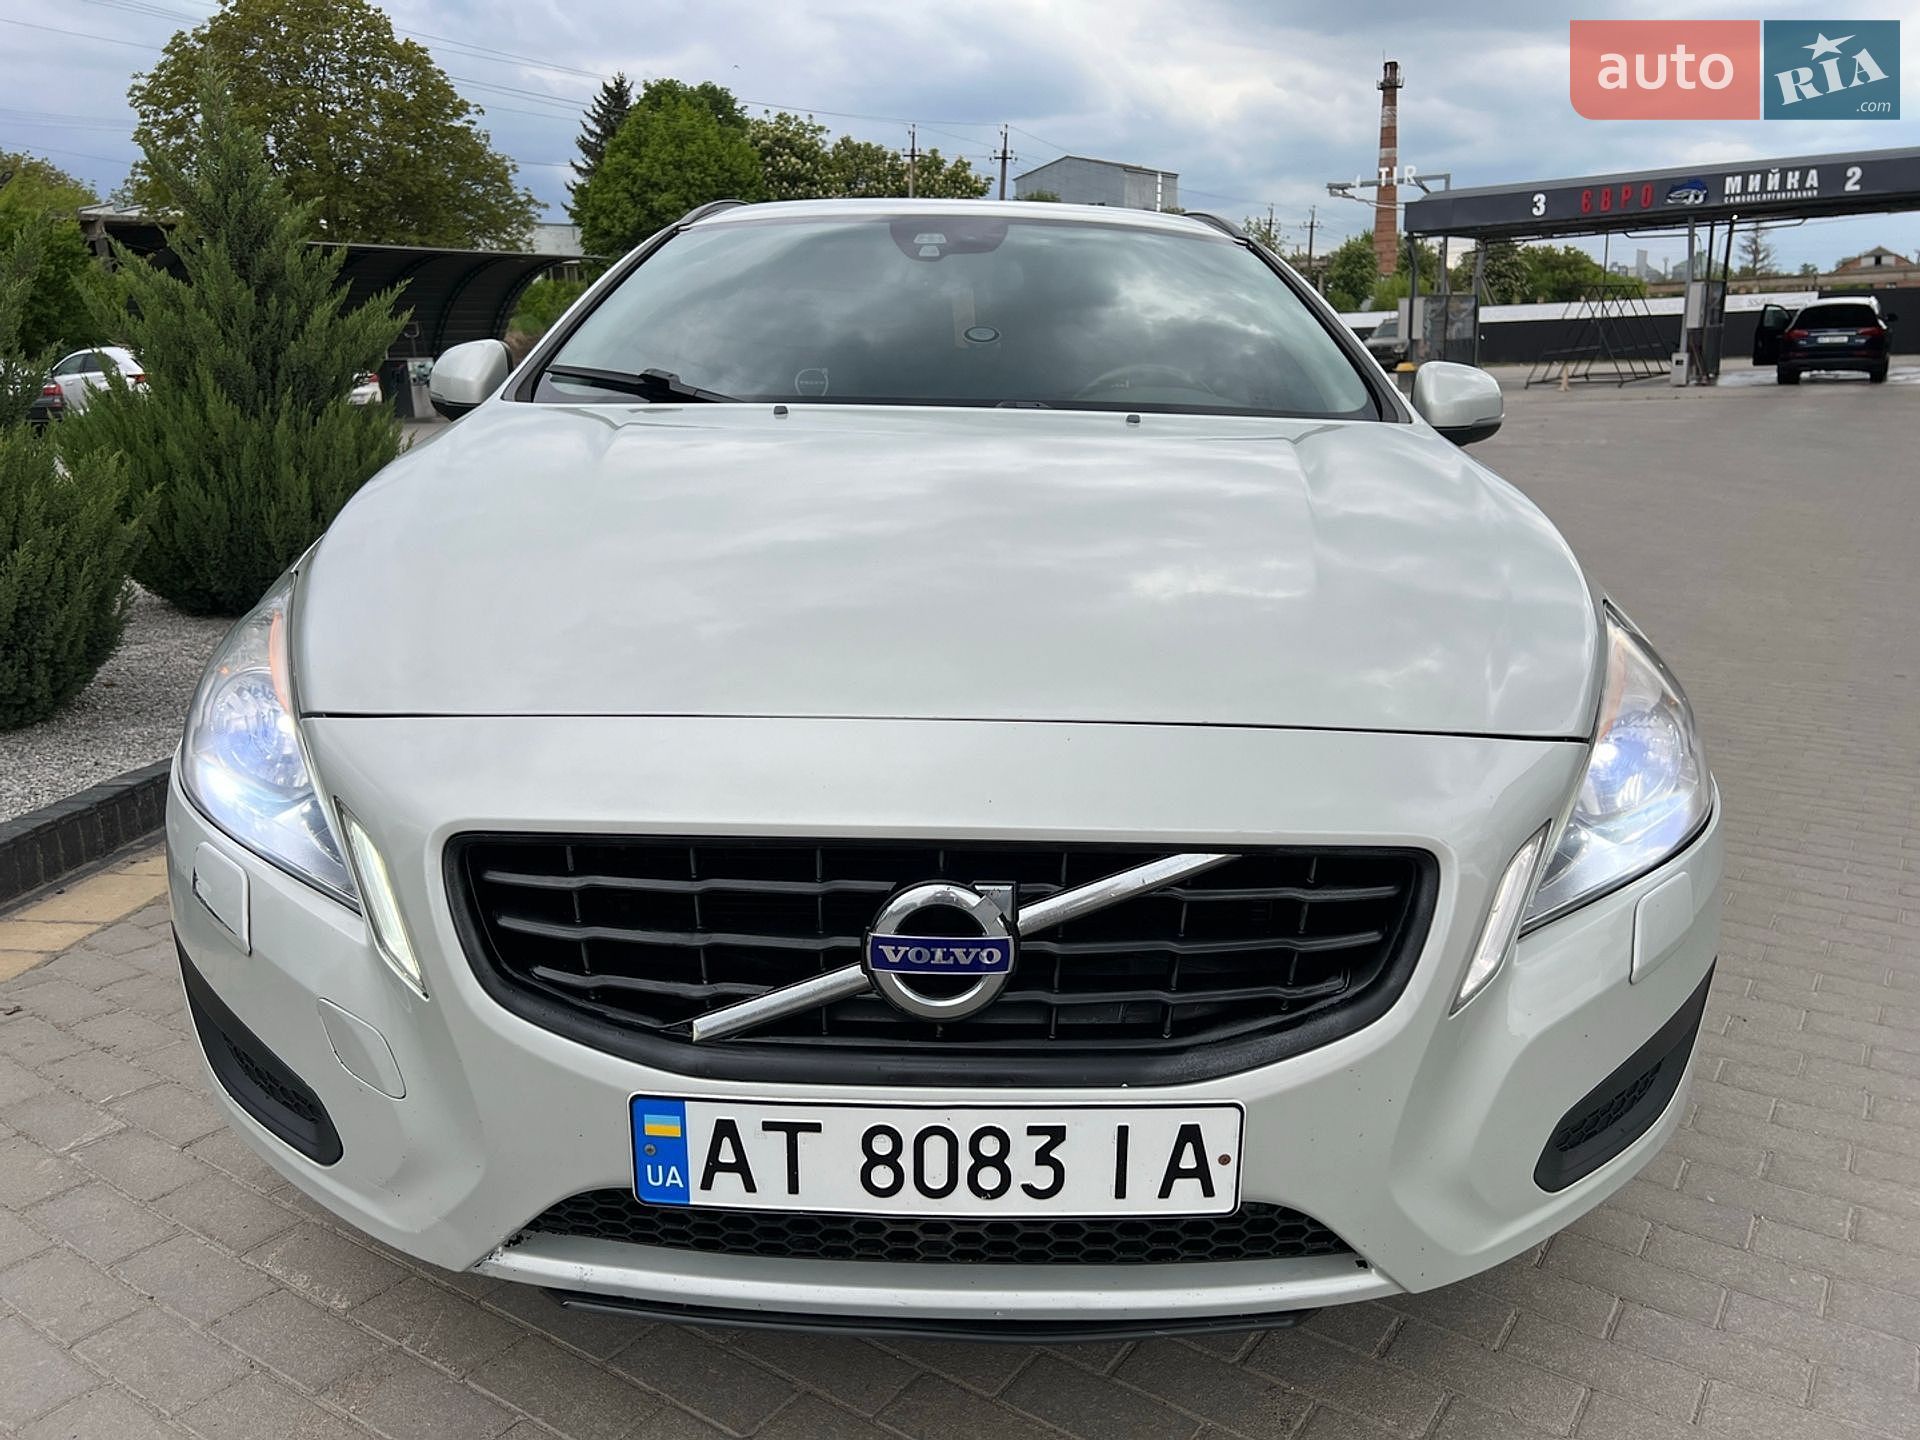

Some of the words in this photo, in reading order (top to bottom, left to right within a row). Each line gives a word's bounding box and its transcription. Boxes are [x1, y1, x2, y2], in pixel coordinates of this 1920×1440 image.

[1724, 168, 1819, 195] МИЙКА
[1844, 166, 1862, 192] 2
[1532, 193, 1547, 216] 3
[878, 945, 1002, 965] VOLVO
[700, 1118, 823, 1195] AT
[860, 1124, 1067, 1200] 8083
[1114, 1123, 1216, 1200] IA
[646, 1165, 684, 1188] UA
